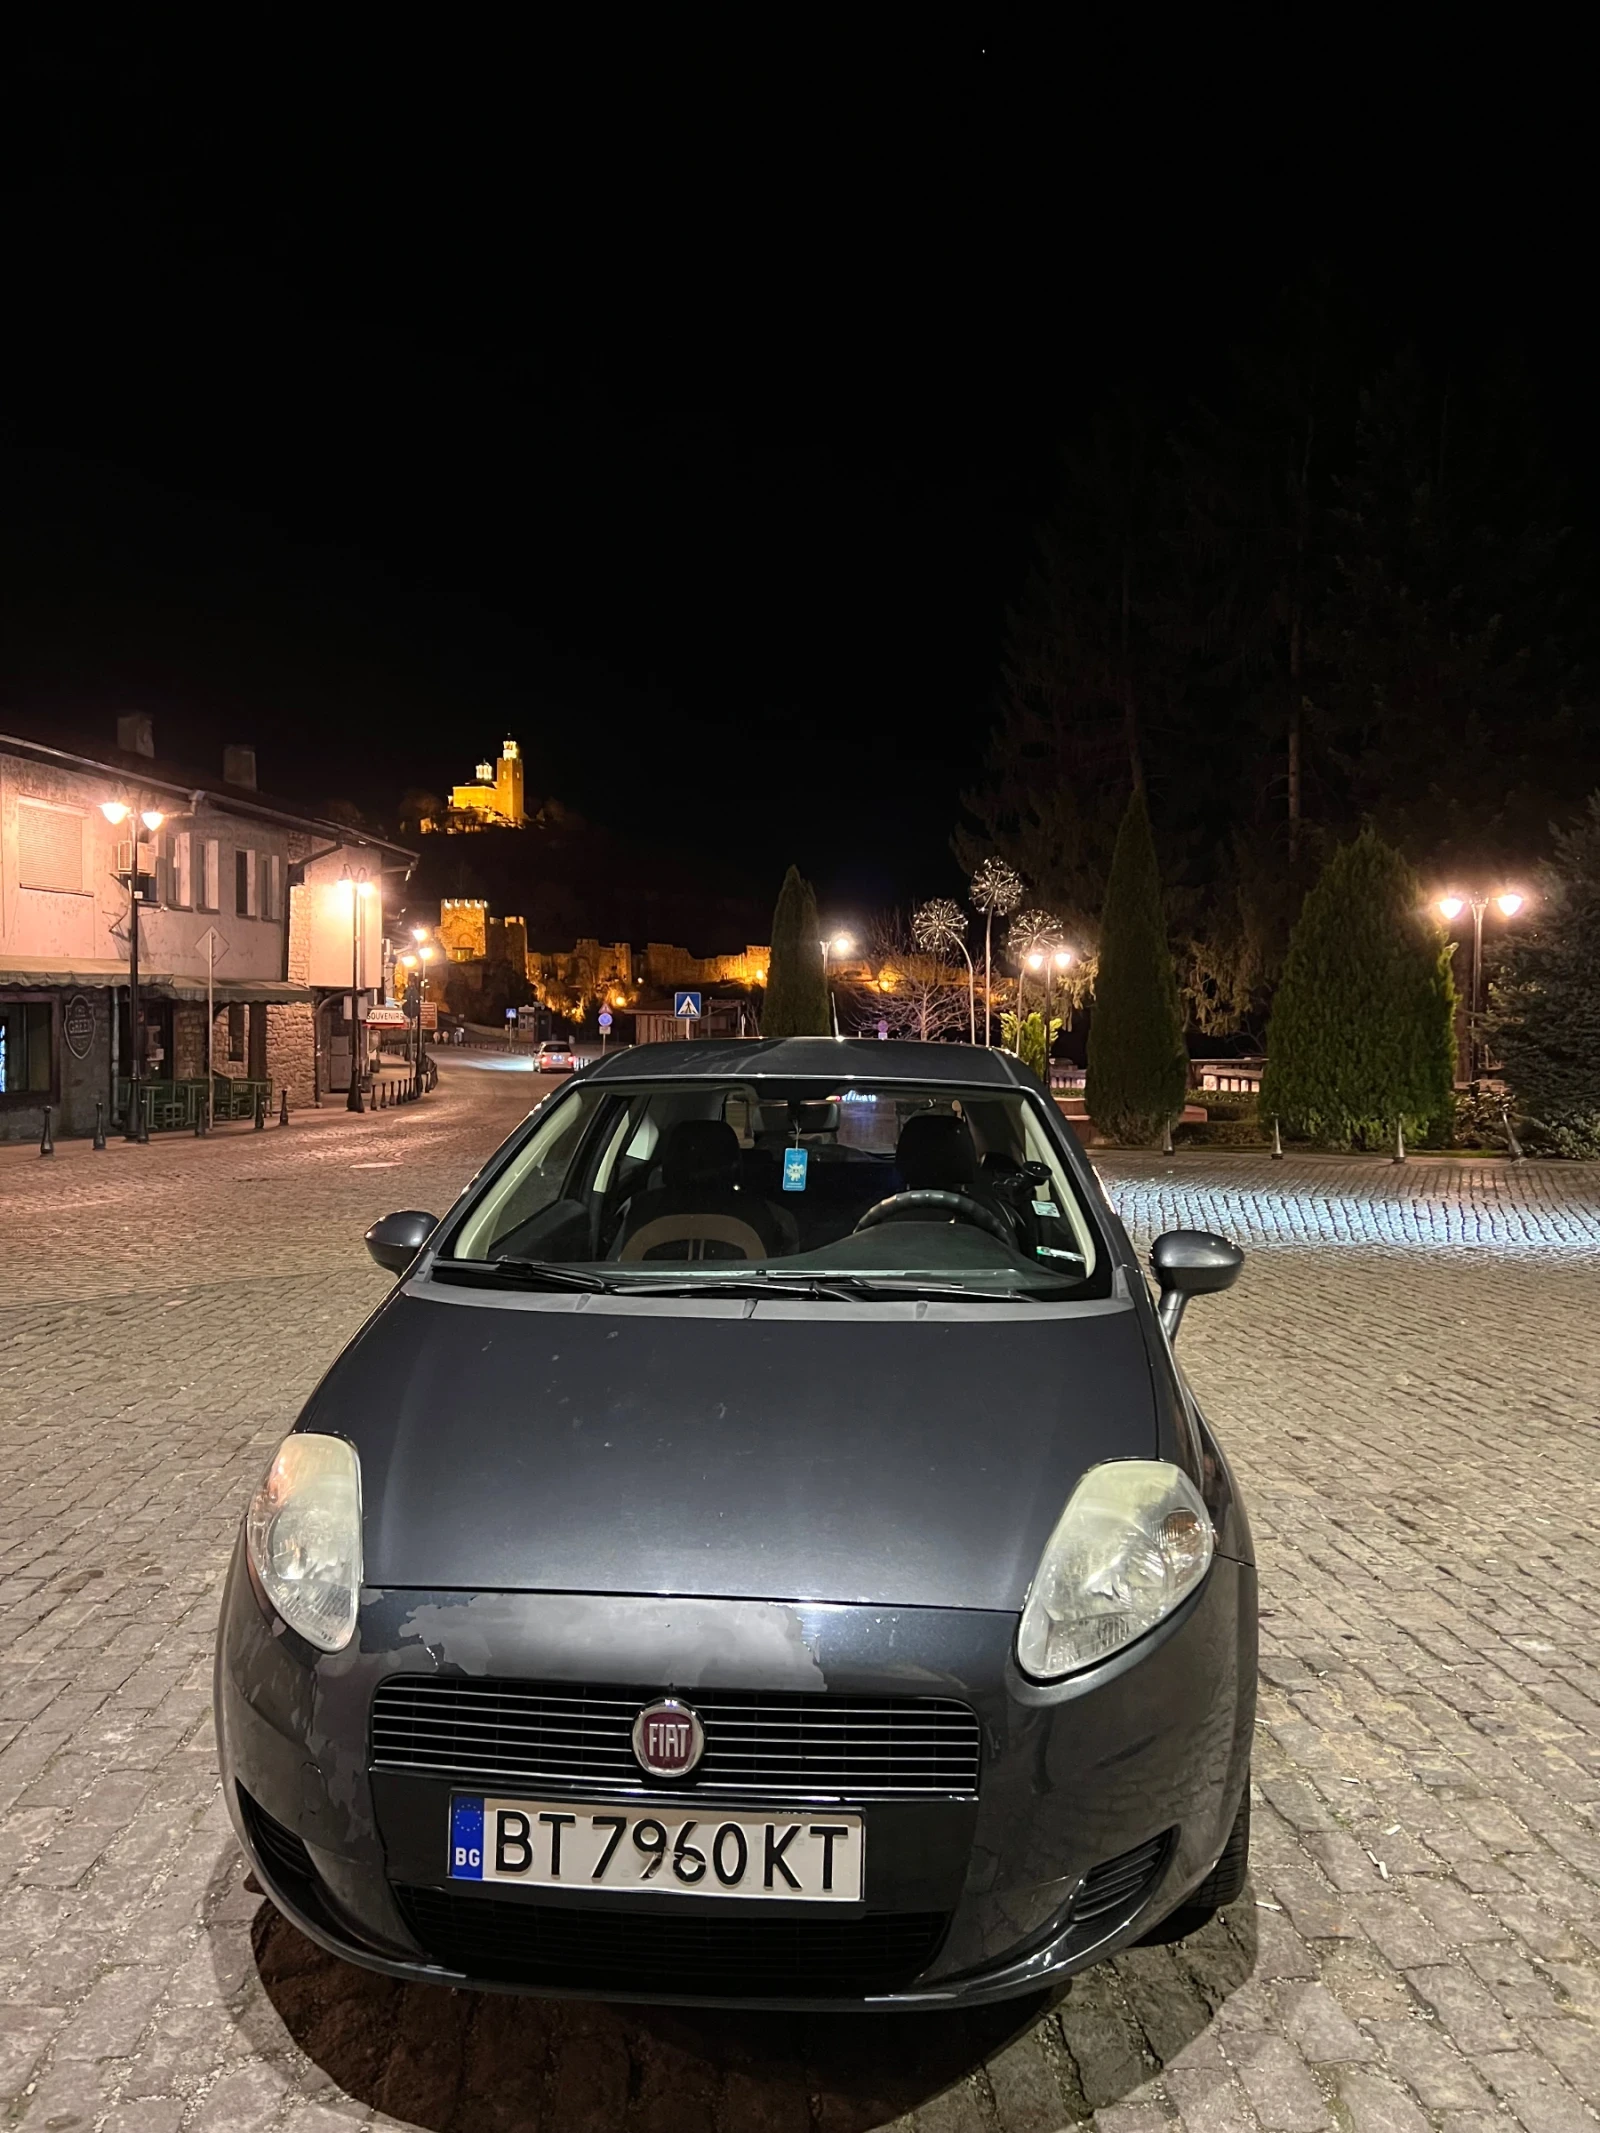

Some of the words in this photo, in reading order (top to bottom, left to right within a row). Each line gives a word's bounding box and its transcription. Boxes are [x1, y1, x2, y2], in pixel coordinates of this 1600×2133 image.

[366, 1011, 404, 1021] SOUVENIRS
[649, 1723, 690, 1758] FIAT
[455, 1847, 481, 1867] BG
[495, 1809, 576, 1879] BT
[591, 1815, 748, 1886] 7960
[763, 1823, 849, 1892] KT
